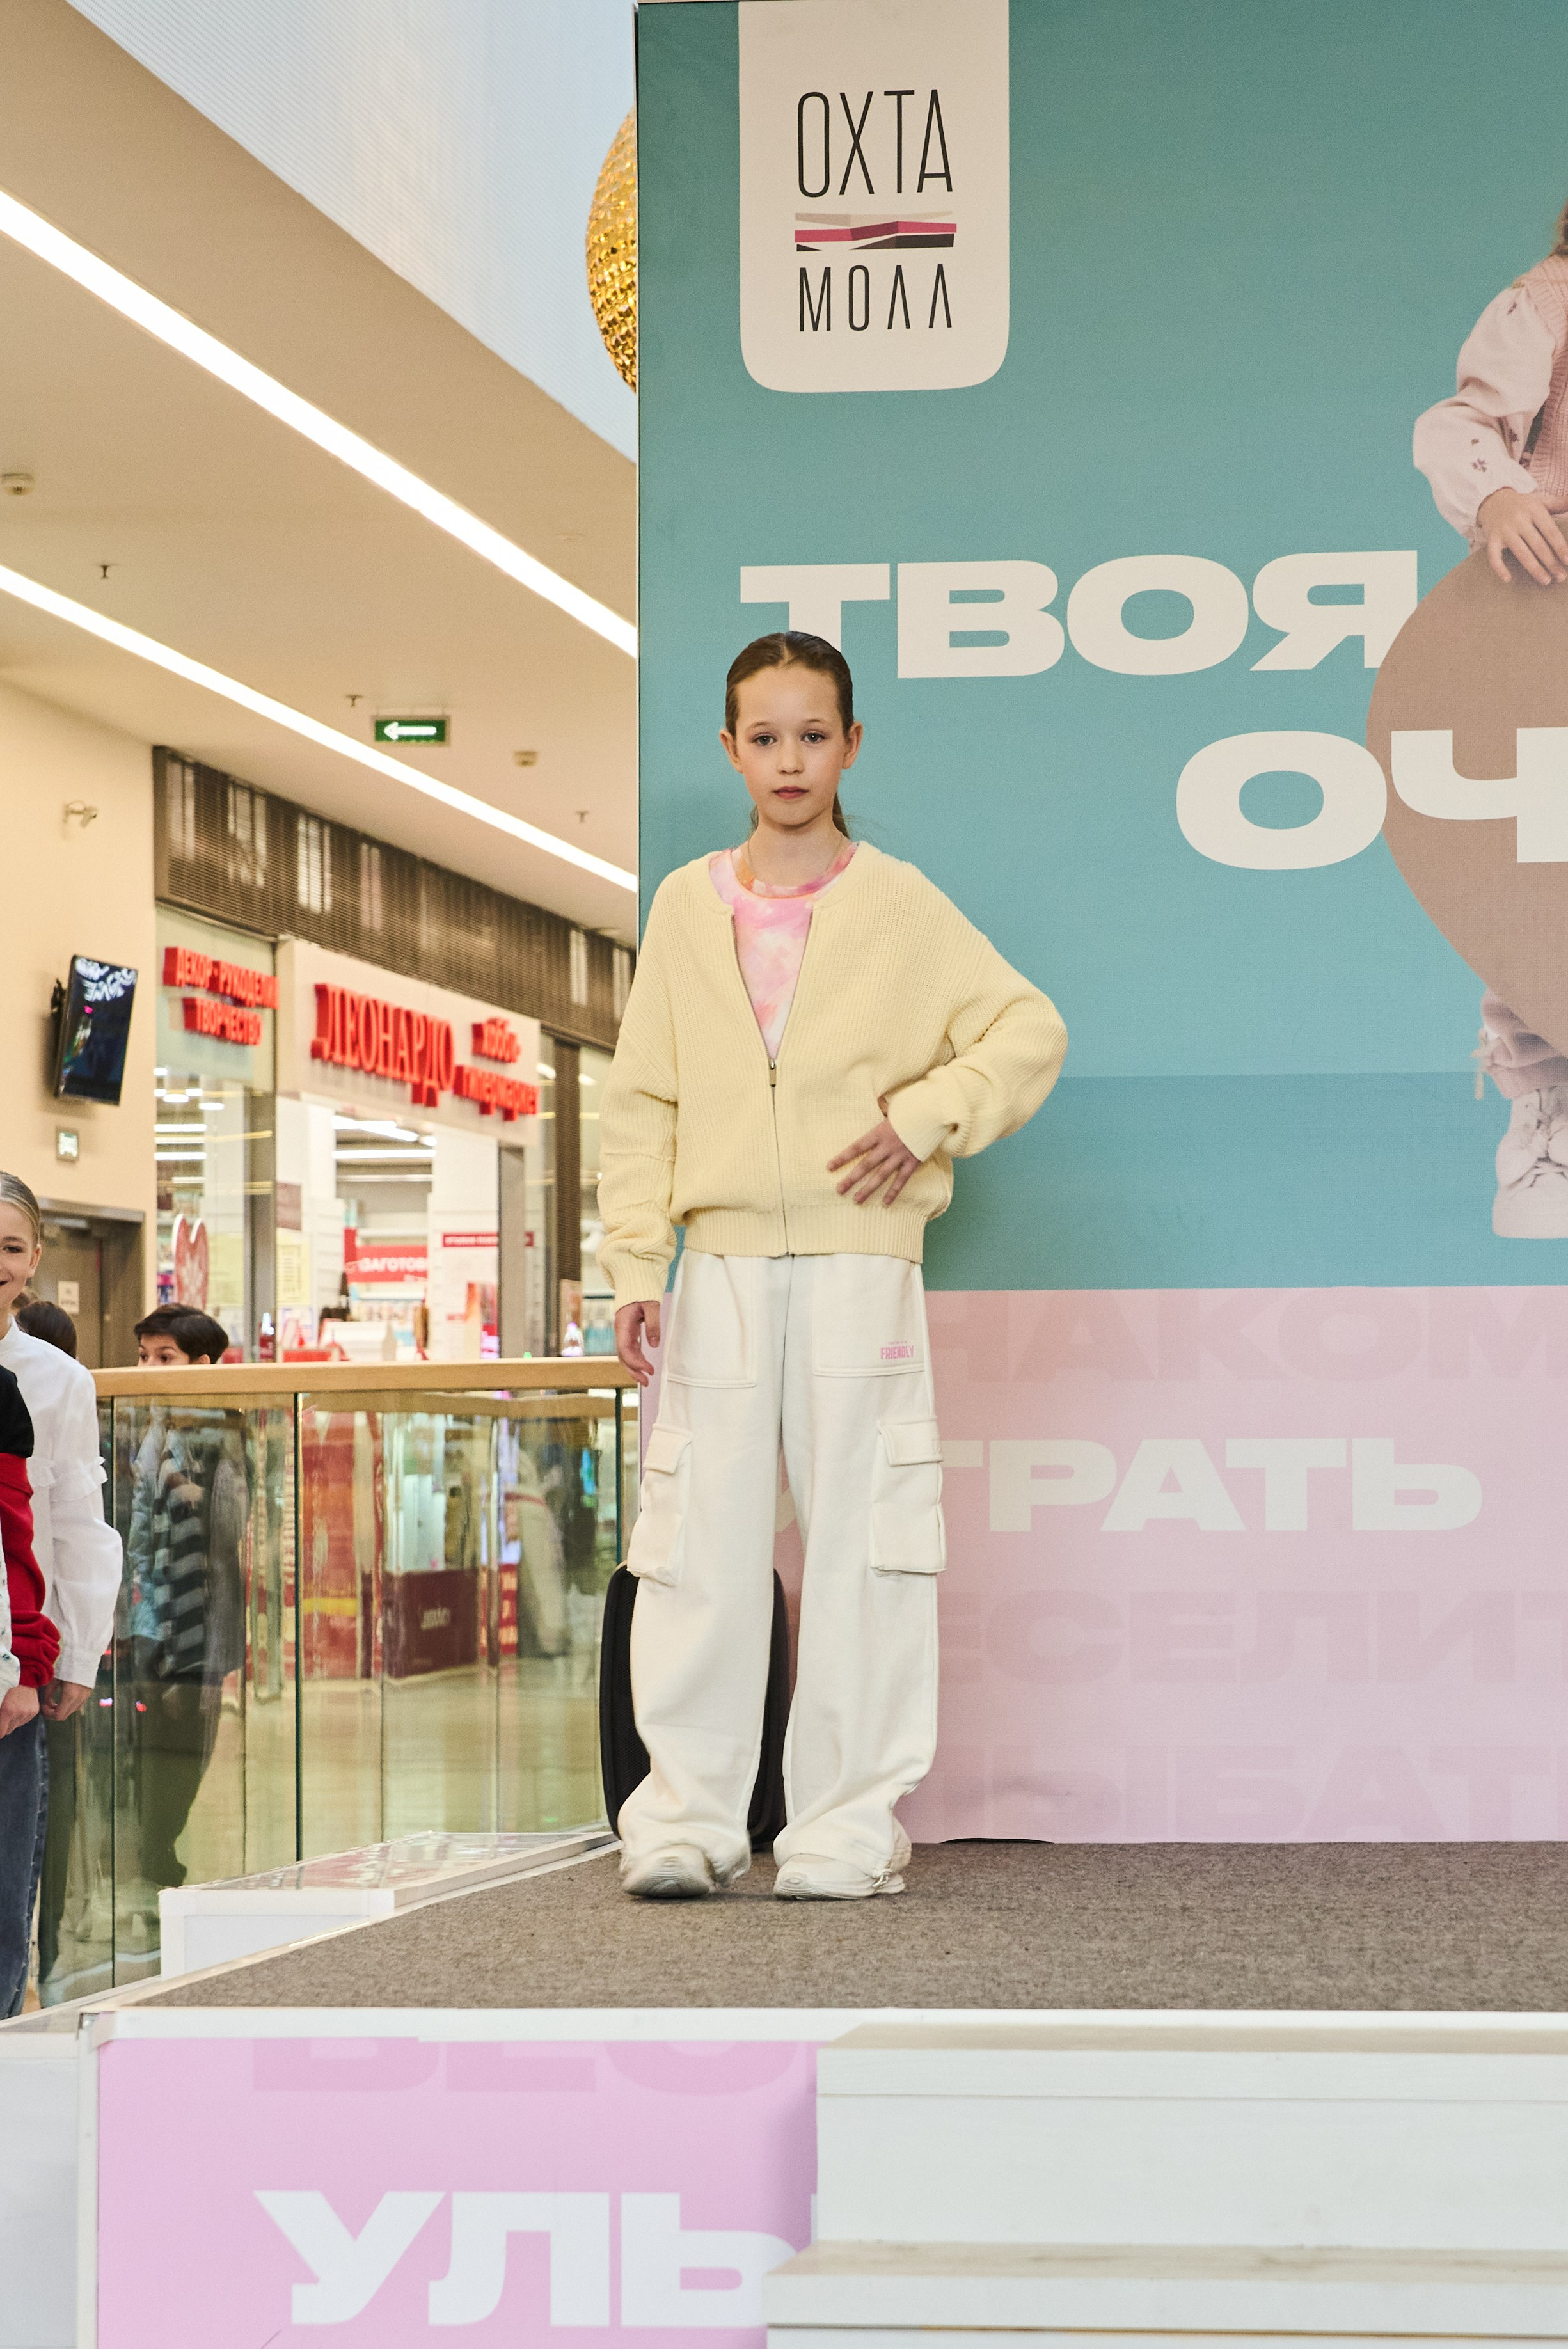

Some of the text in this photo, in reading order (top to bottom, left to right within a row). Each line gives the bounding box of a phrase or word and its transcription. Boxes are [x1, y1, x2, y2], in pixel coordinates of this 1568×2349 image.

[798, 89, 953, 198] ОХТА
[799, 264, 953, 332] МОЛЛ
[740, 550, 1418, 679] ТВОЯ
[312, 983, 454, 1107] ЛЕОНАРДО
[880, 1345, 914, 1360] FRIENDLY
[942, 1437, 1483, 1532] РАТЬ
